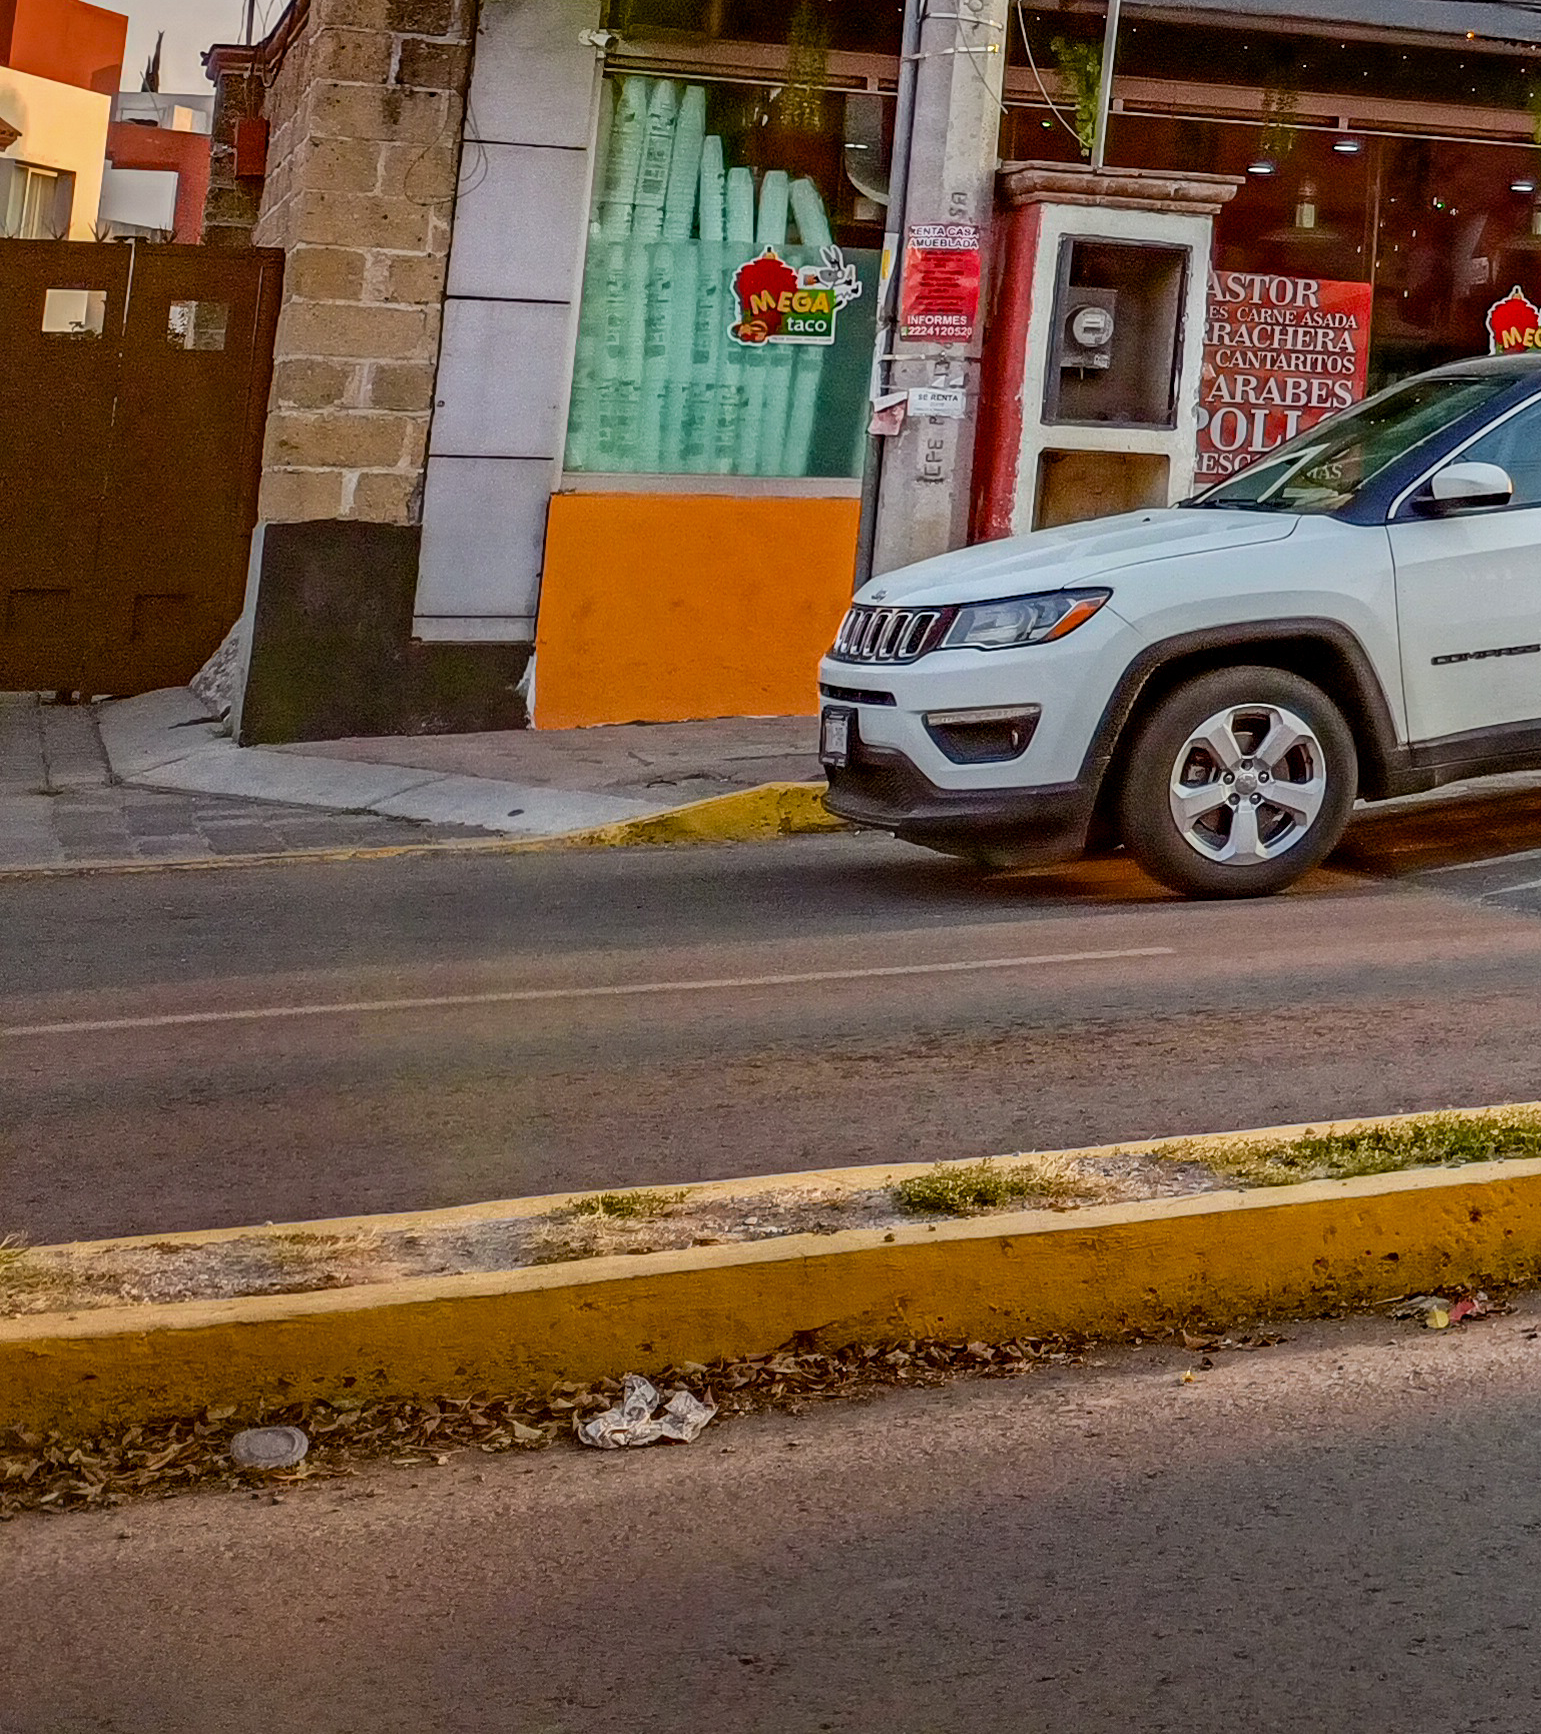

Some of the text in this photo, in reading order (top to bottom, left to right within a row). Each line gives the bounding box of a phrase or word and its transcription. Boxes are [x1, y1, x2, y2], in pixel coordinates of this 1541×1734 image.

[749, 289, 830, 315] MEGA
[786, 316, 828, 332] taco
[907, 315, 968, 326] INFORMES
[1236, 306, 1297, 326] CARNE
[1300, 312, 1358, 329] ASADA
[1215, 348, 1356, 375] CANTARITOS
[930, 393, 959, 402] RENTA
[1204, 374, 1353, 409] ARABES
